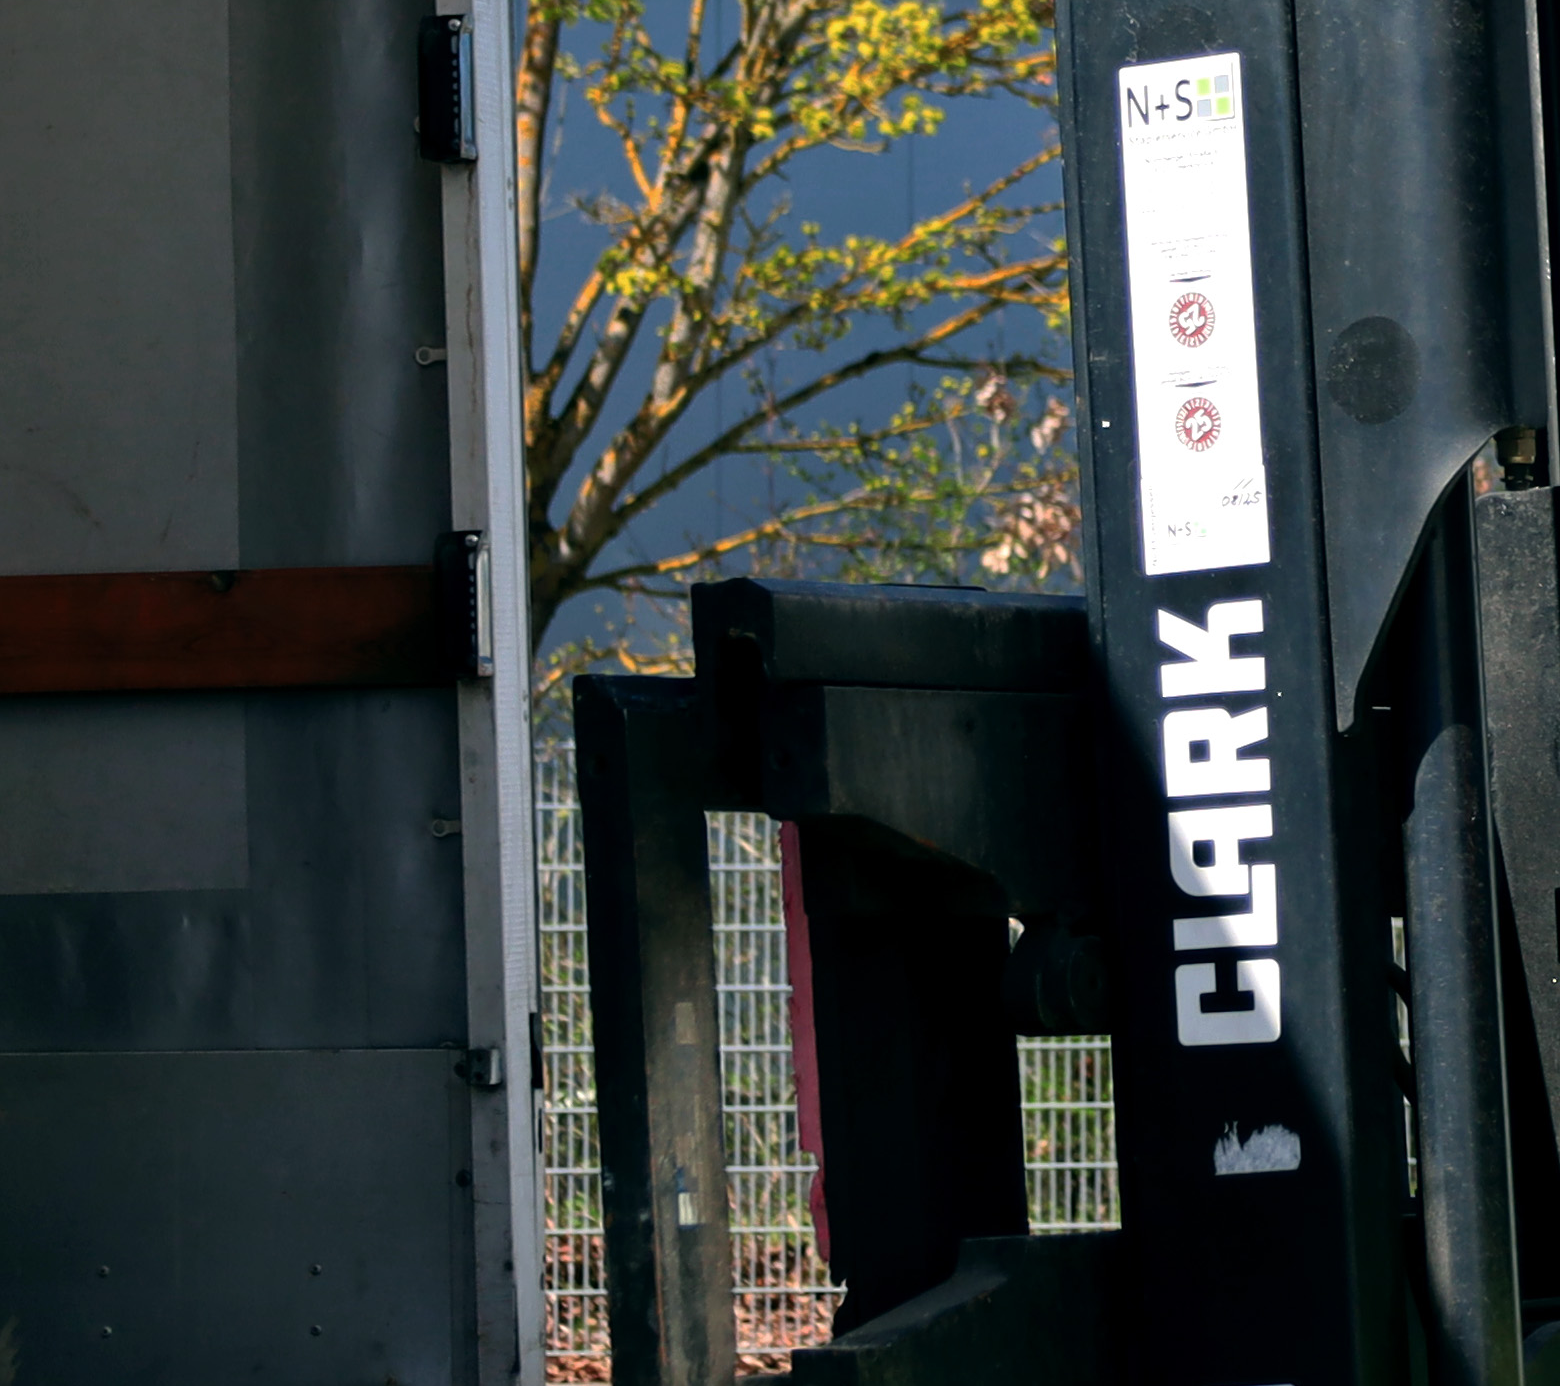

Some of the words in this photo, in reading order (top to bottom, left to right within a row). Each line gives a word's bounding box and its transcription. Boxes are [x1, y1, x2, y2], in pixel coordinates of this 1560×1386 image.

[1126, 78, 1194, 128] N+S
[1185, 406, 1212, 441] 25
[1156, 598, 1282, 1047] CLARK
